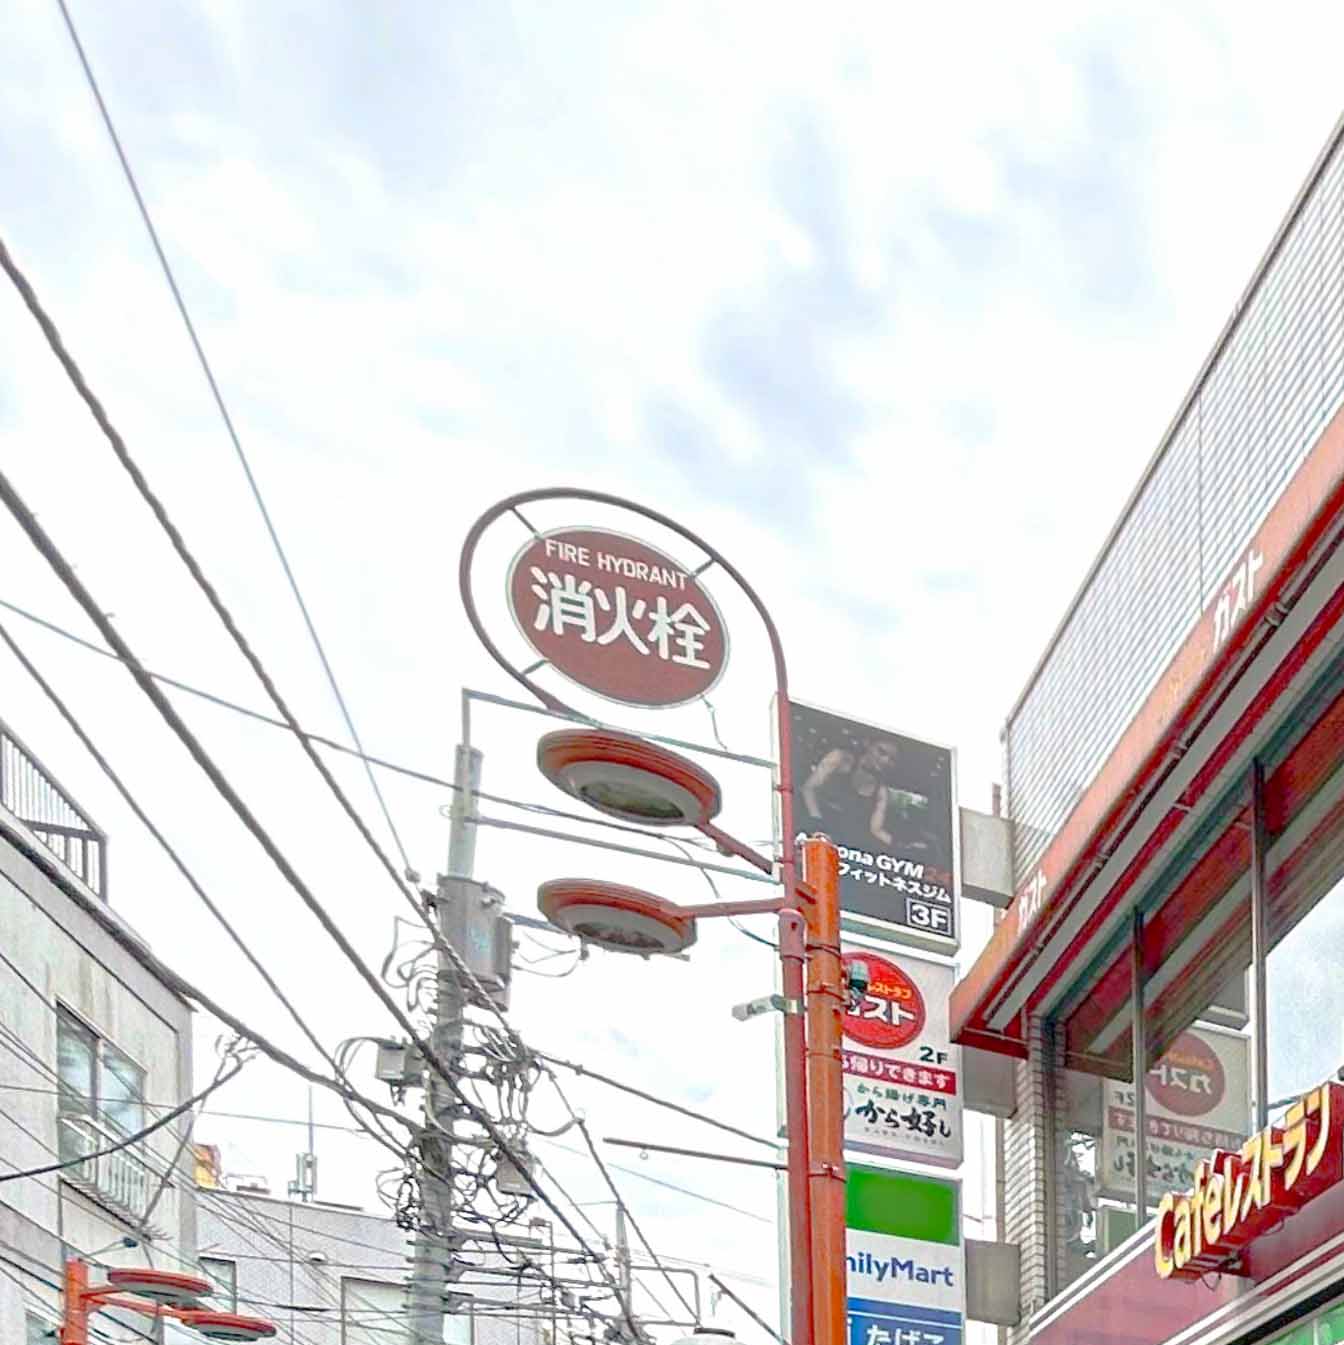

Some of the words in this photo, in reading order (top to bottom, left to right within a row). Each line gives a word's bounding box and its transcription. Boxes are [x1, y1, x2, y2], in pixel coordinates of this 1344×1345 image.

[545, 539, 590, 568] FIRE
[597, 551, 688, 591] HYDRANT
[530, 565, 711, 670] 消火栓
[838, 862, 953, 903] フィットネスジム
[876, 855, 924, 879] GYM
[911, 903, 947, 928] 3F
[841, 1055, 949, 1089] 帰りできます
[919, 1045, 949, 1065] 2F
[845, 1251, 955, 1288] ilyMart
